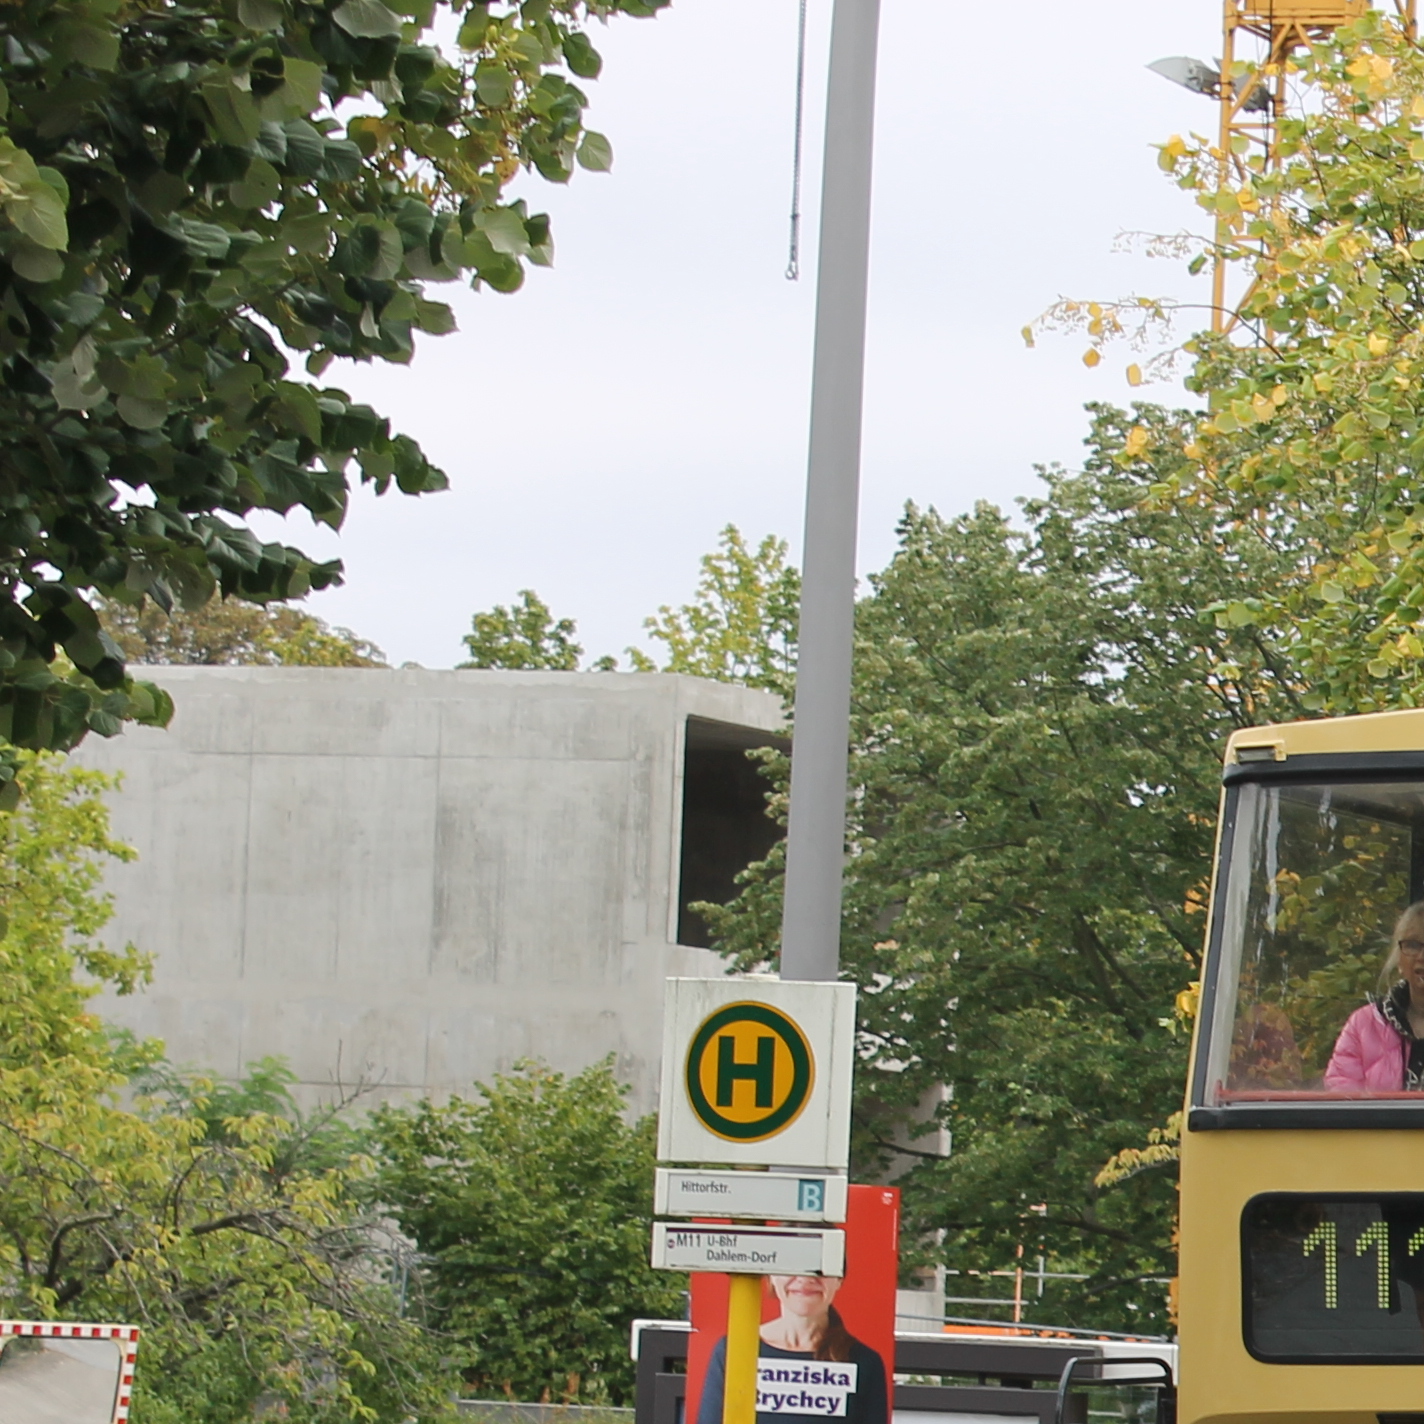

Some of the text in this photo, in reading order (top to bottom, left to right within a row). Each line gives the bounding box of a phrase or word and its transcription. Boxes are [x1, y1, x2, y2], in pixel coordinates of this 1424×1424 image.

[716, 1035, 775, 1109] H
[680, 1180, 732, 1195] Hittorfstr.
[802, 1184, 821, 1212] B
[676, 1234, 701, 1248] M11
[707, 1235, 738, 1248] U-Bhf
[706, 1249, 777, 1264] Dahlem-Dorf
[757, 1366, 850, 1387] anziska
